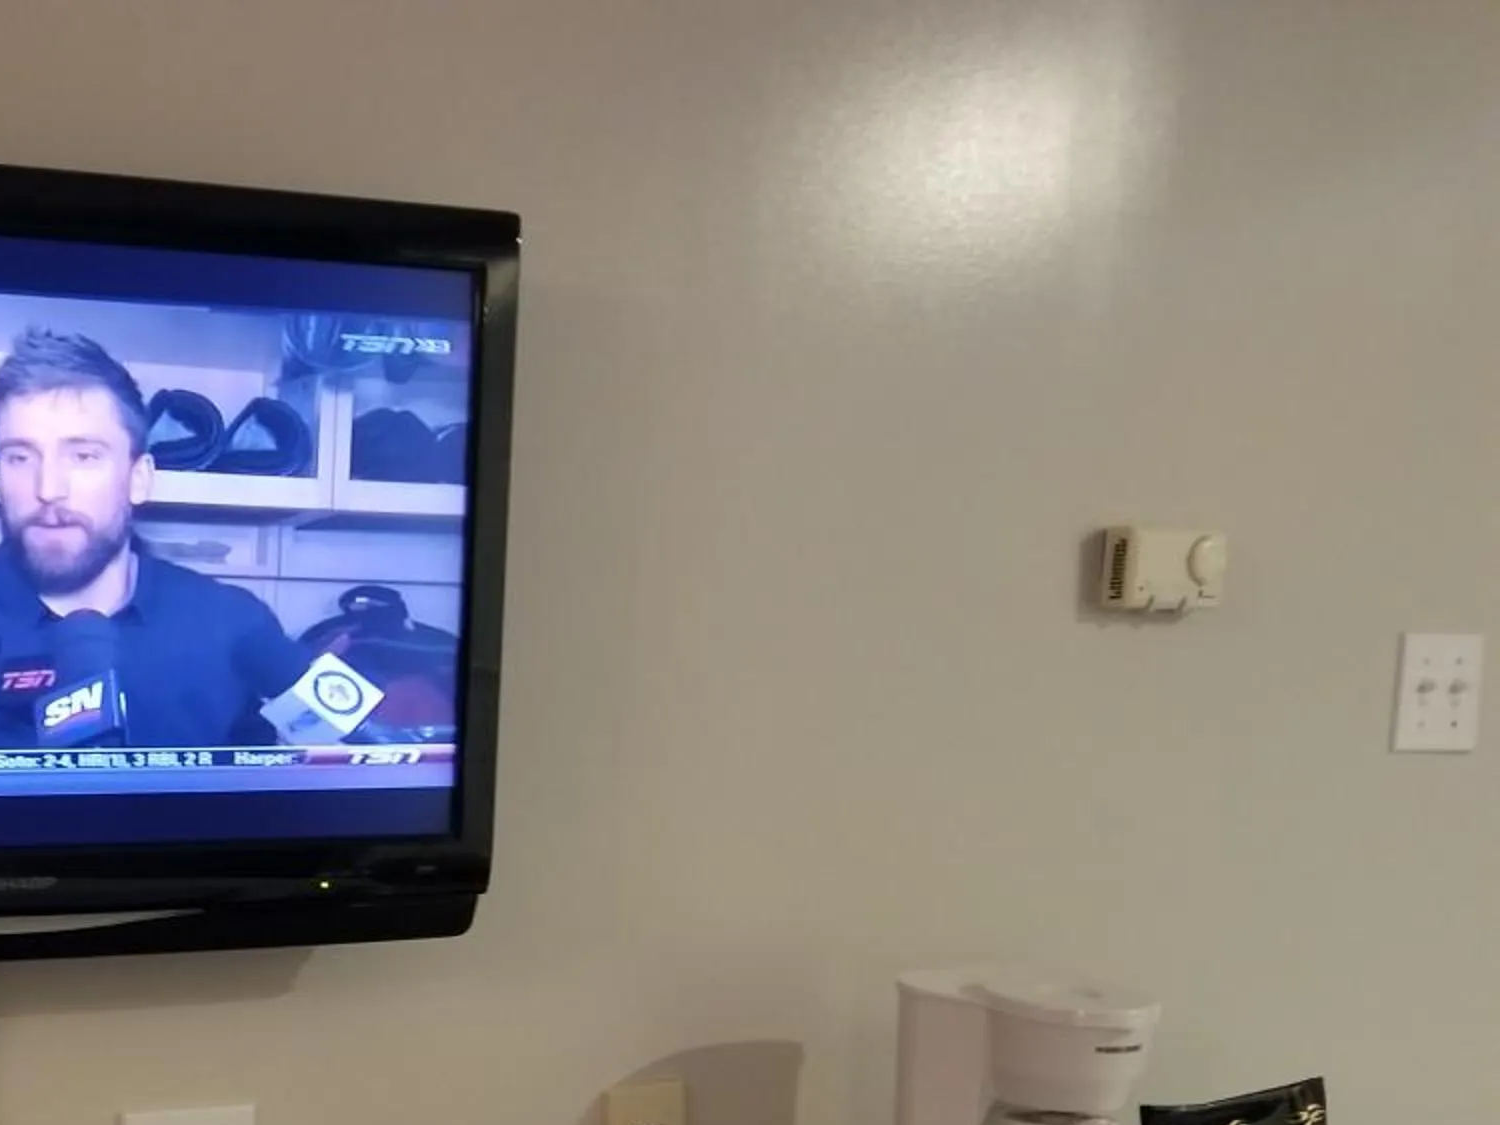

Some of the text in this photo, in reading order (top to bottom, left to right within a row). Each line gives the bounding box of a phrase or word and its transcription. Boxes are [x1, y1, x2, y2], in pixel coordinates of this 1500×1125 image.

[3, 669, 56, 690] TSN
[43, 680, 103, 727] SN
[43, 753, 77, 769] 2-4,
[133, 753, 146, 767] 3
[184, 752, 196, 766] 2
[198, 751, 213, 766] R
[348, 748, 421, 766] TSN
